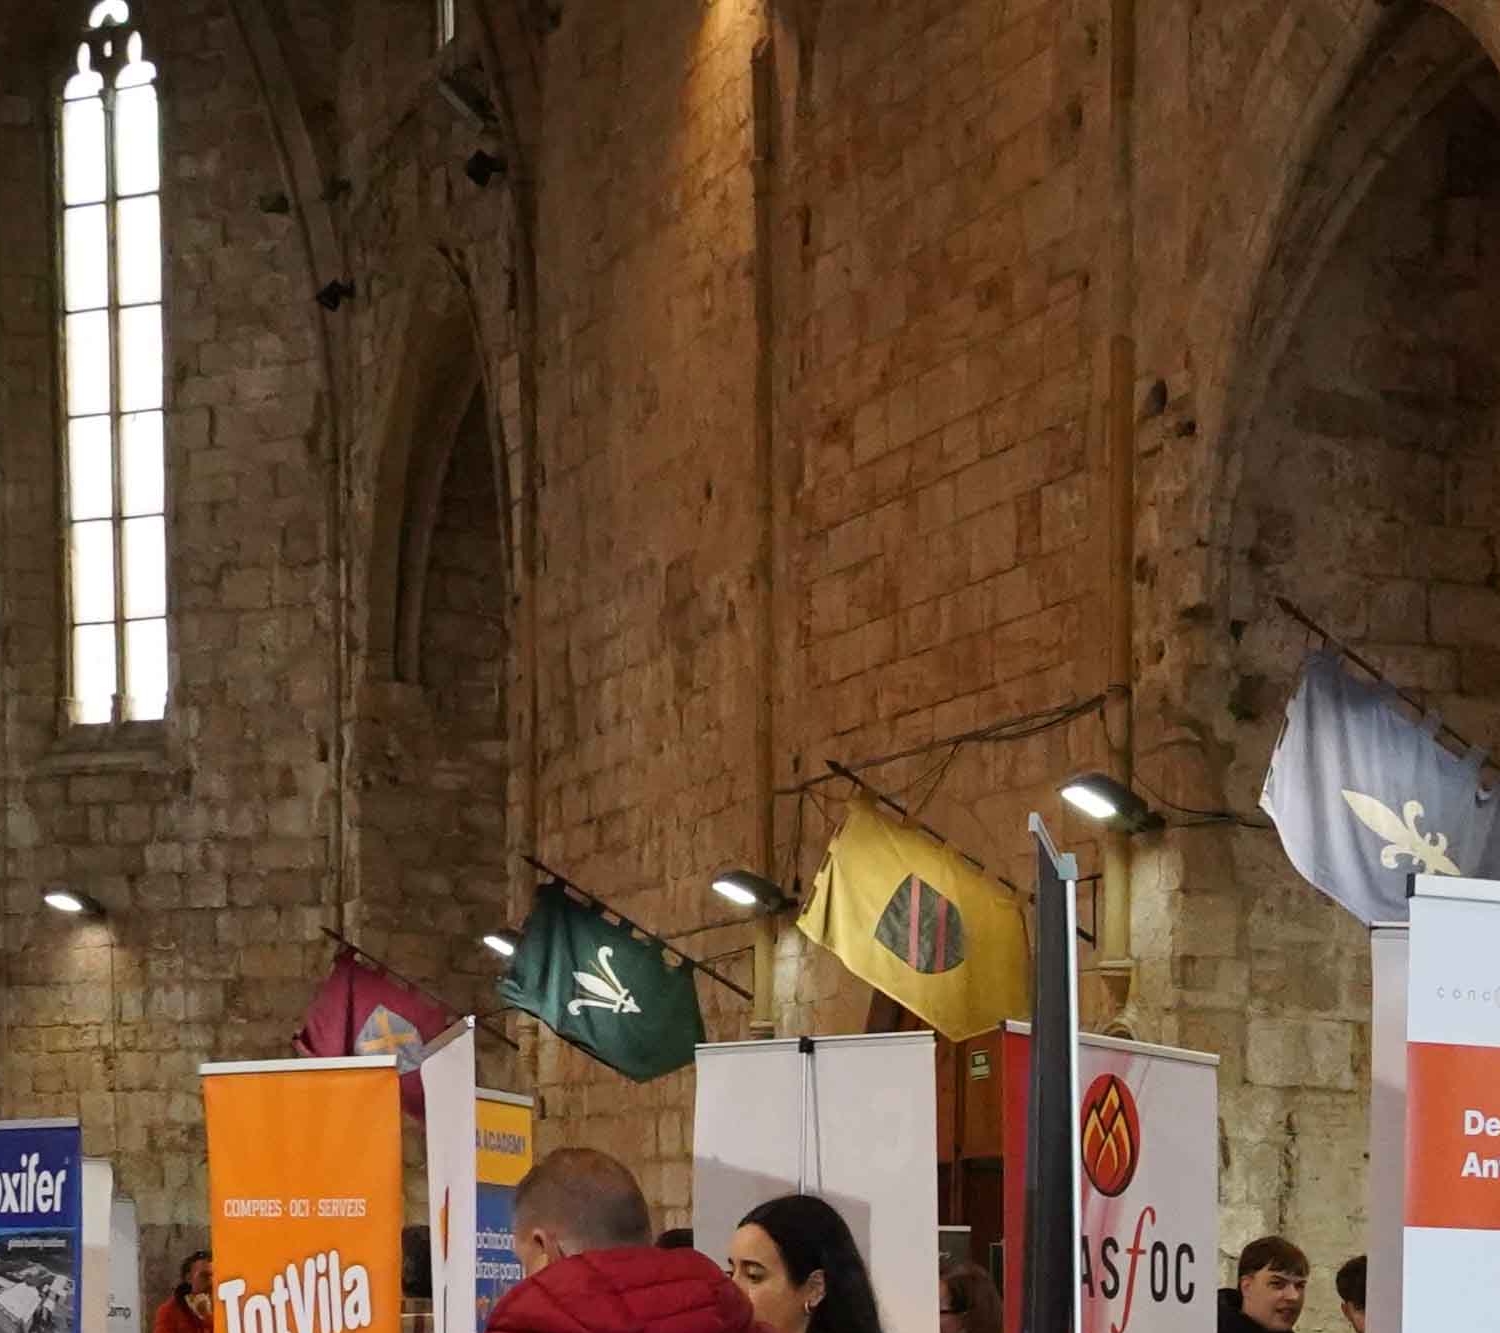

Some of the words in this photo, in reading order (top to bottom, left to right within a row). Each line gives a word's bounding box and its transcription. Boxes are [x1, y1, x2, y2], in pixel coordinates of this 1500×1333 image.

[1464, 1110, 1500, 1136] De
[224, 1199, 282, 1217] COMPRES
[290, 1199, 309, 1217] OCI
[317, 1198, 366, 1217] SERVEIS
